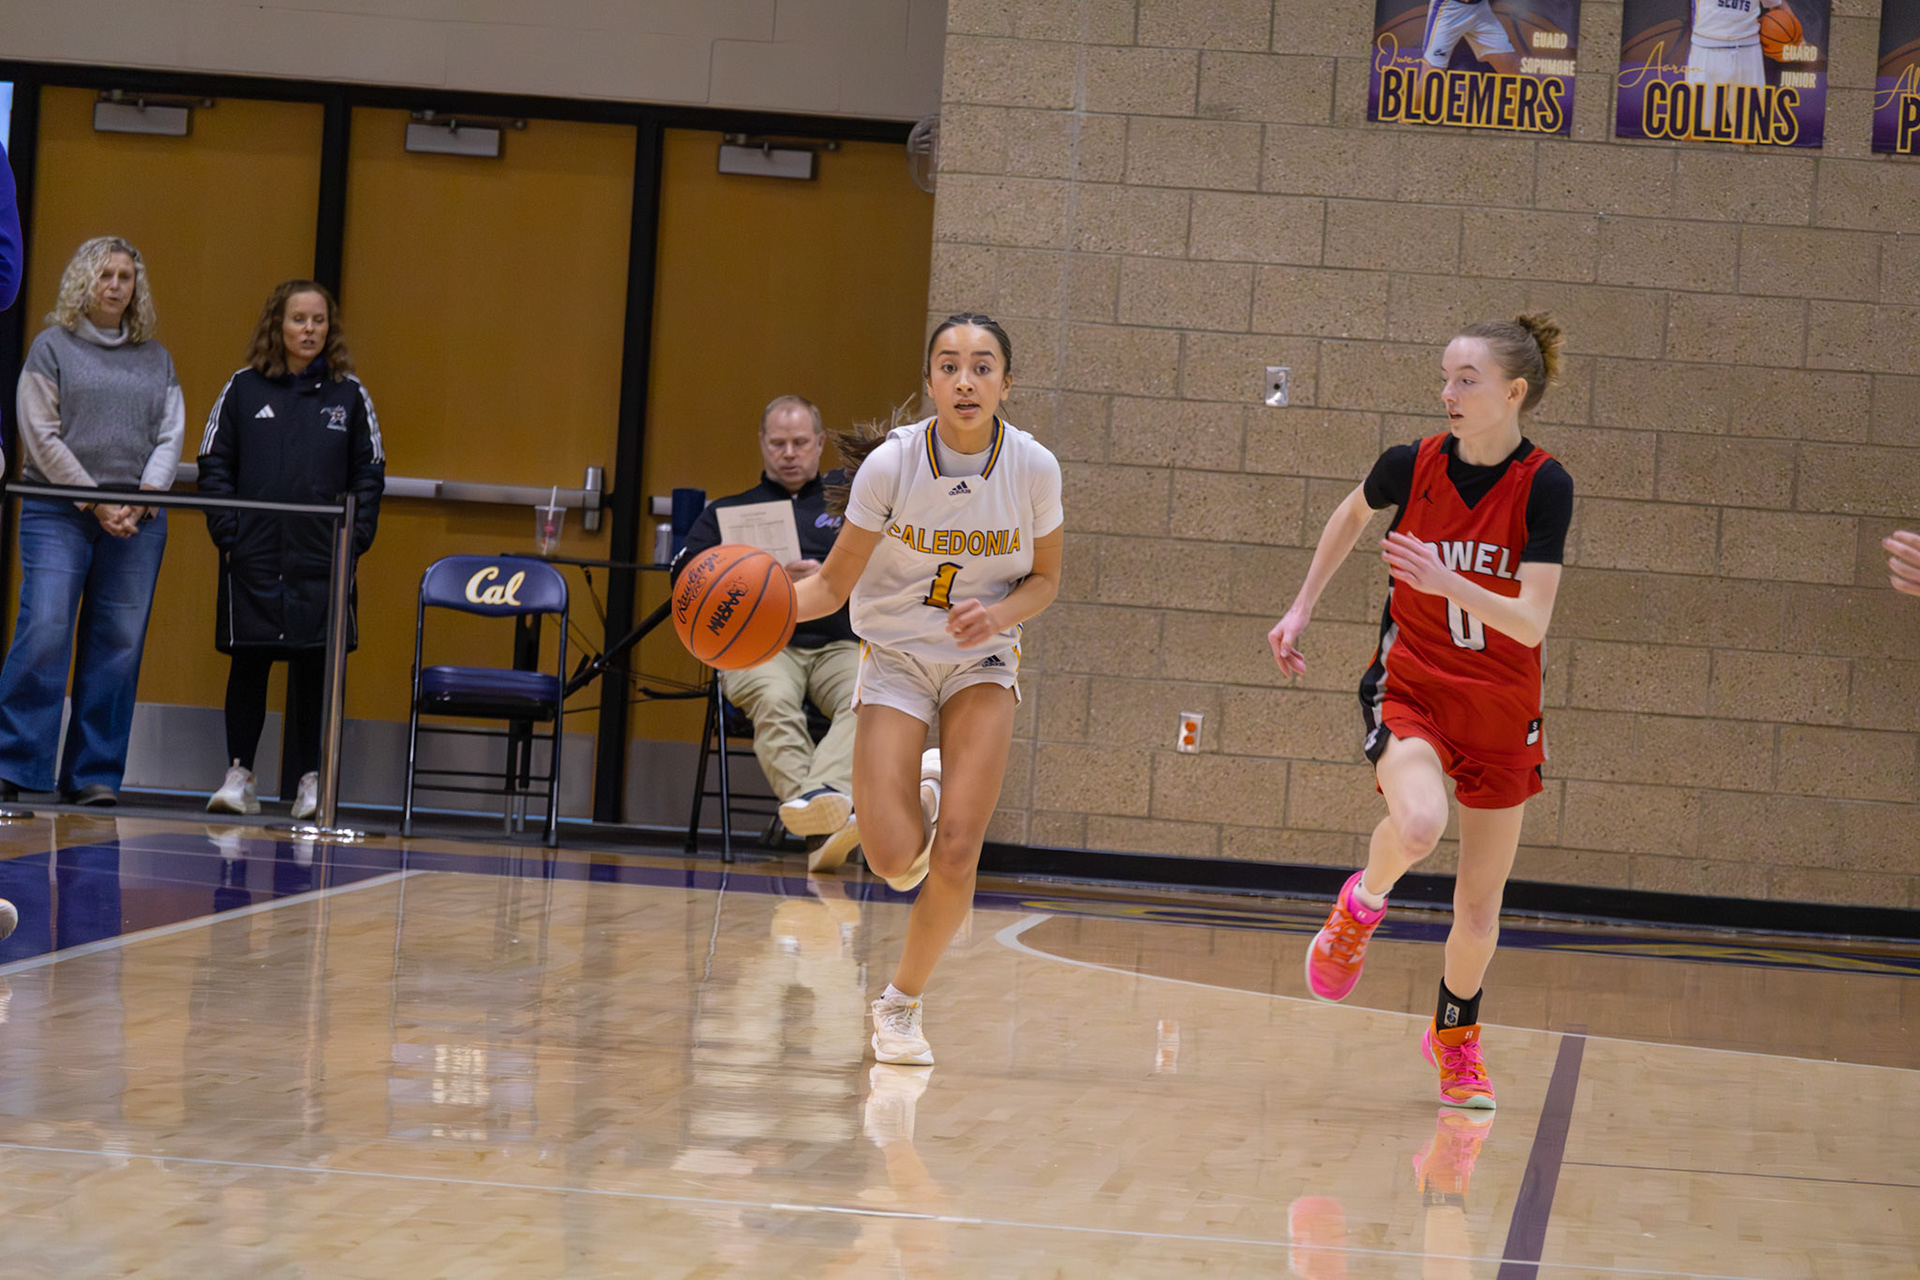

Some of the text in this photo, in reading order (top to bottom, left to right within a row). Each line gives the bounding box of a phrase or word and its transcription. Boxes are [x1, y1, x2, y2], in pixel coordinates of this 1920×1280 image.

[1533, 31, 1568, 49] GUARD
[1782, 45, 1818, 61] GUARD
[1780, 71, 1816, 88] JUNIOR
[1378, 66, 1565, 132] BLOEMERS
[1642, 79, 1800, 145] COLLINS
[887, 524, 1021, 557] CALEDONIA
[465, 566, 526, 606] Cal
[922, 562, 964, 610] 1
